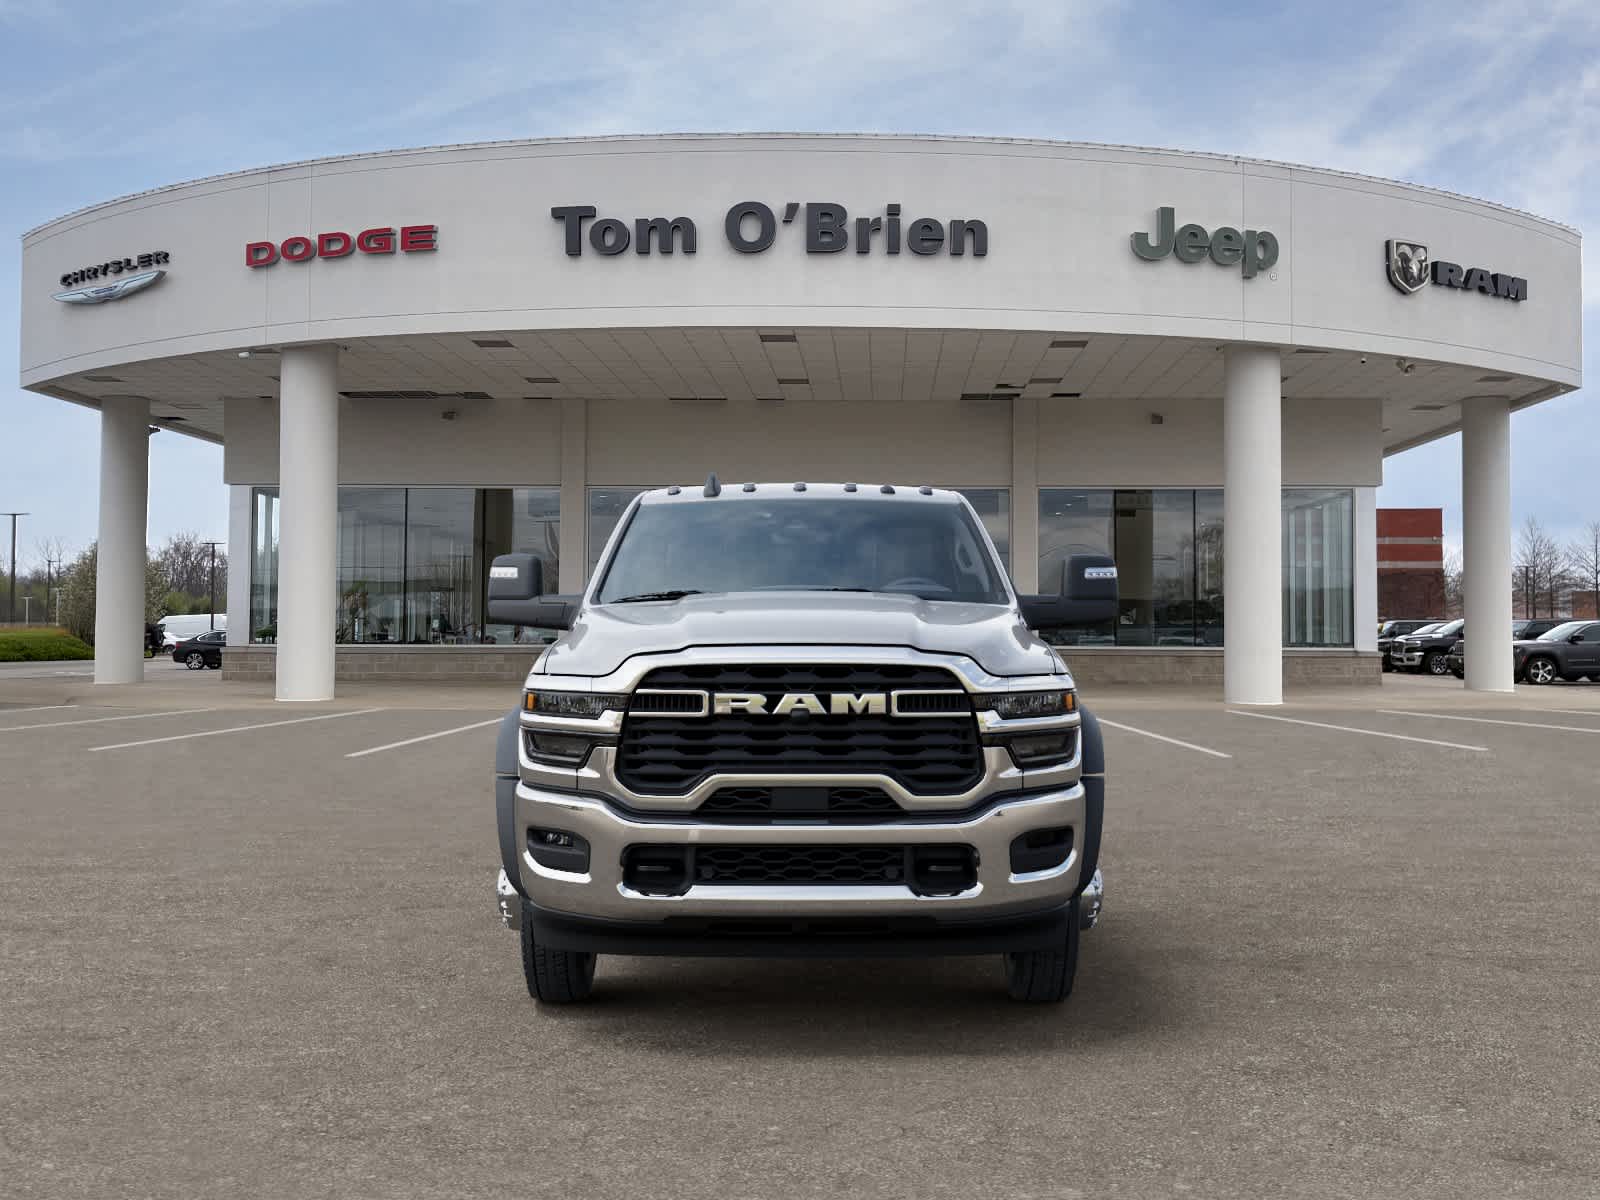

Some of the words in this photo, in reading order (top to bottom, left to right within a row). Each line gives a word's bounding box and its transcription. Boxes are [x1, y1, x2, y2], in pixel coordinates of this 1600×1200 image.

[246, 225, 439, 270] DODGE
[551, 205, 698, 256] Tom
[725, 201, 989, 256] O'Brien
[1130, 206, 1279, 279] Jeep
[60, 250, 170, 287] CHRYSLER
[1431, 261, 1528, 301] RAM
[713, 692, 887, 715] RAM
